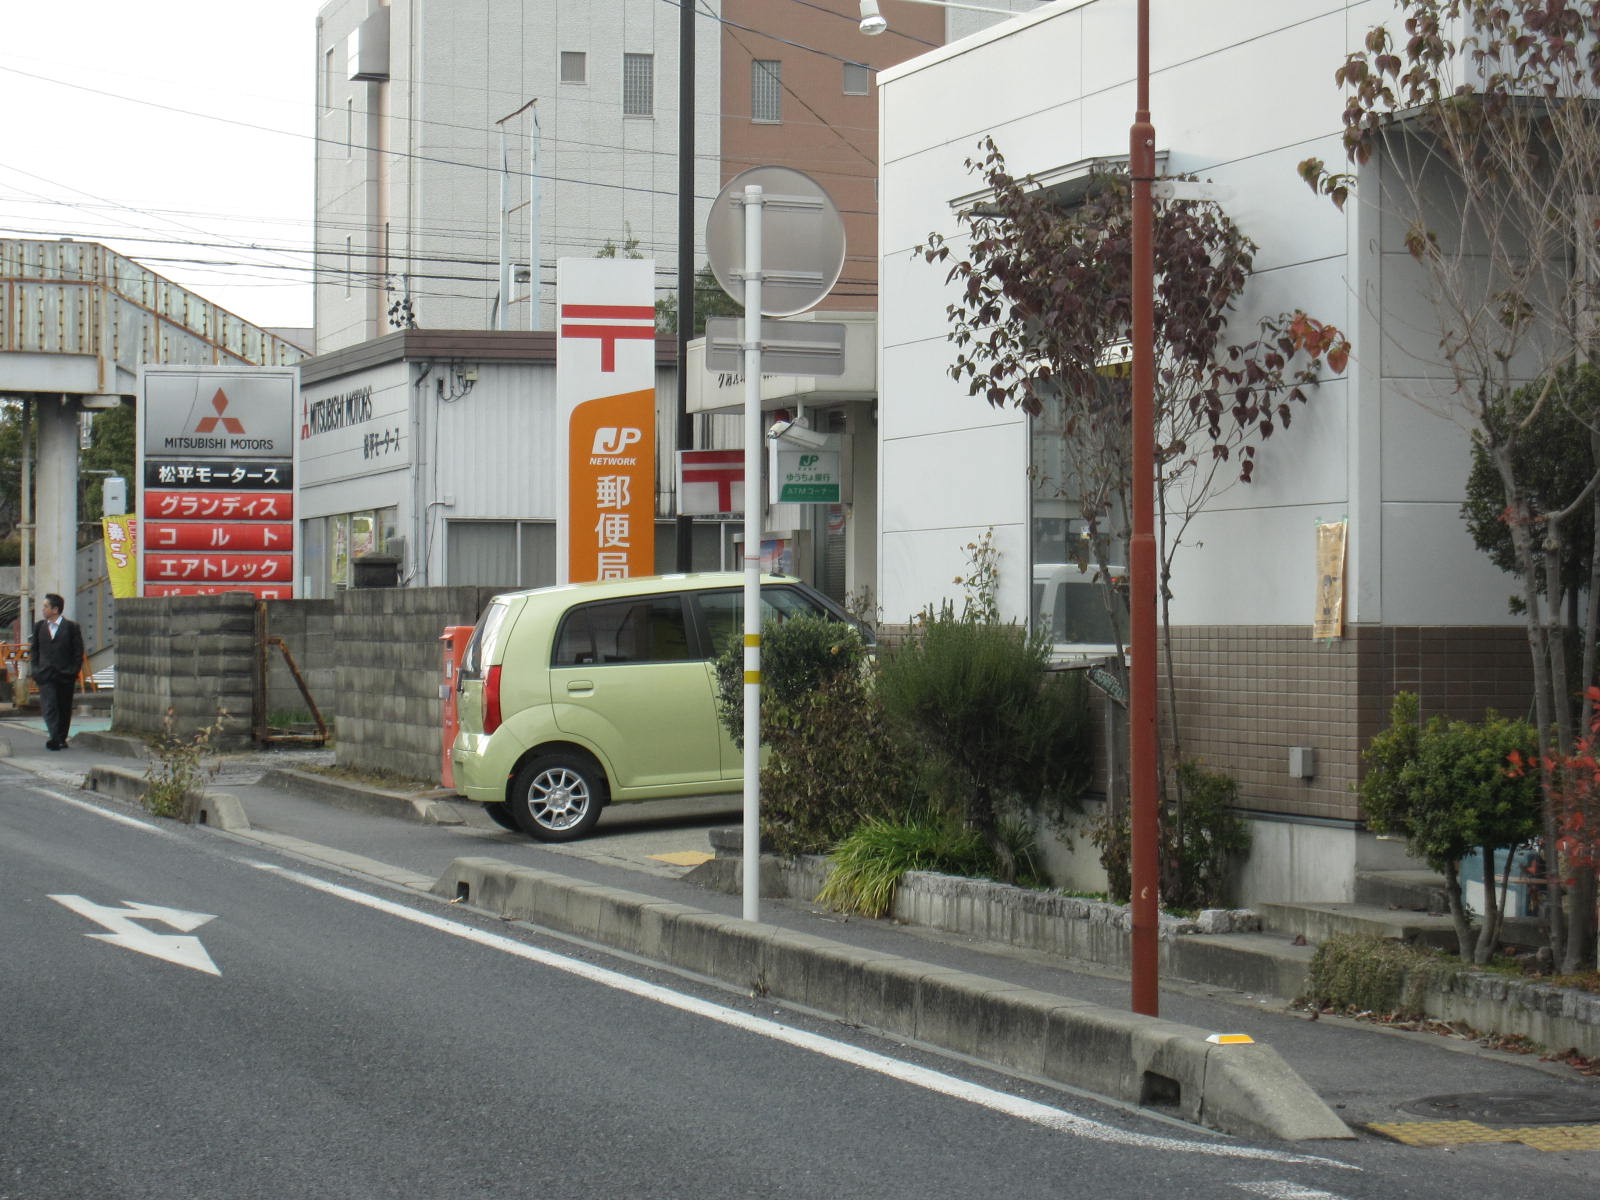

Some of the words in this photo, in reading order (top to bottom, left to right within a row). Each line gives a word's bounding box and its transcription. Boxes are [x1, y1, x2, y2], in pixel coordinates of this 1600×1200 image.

[309, 394, 345, 436] MITSUBISHI
[164, 437, 226, 449] MITSUBISHI
[230, 438, 274, 450] MOTORS
[592, 427, 642, 455] JP
[589, 457, 637, 466] NETWORK
[158, 465, 280, 483] 松平モータース
[160, 496, 278, 517] グランディス
[594, 475, 631, 582] 郵便局
[159, 558, 278, 578] エアトレック
